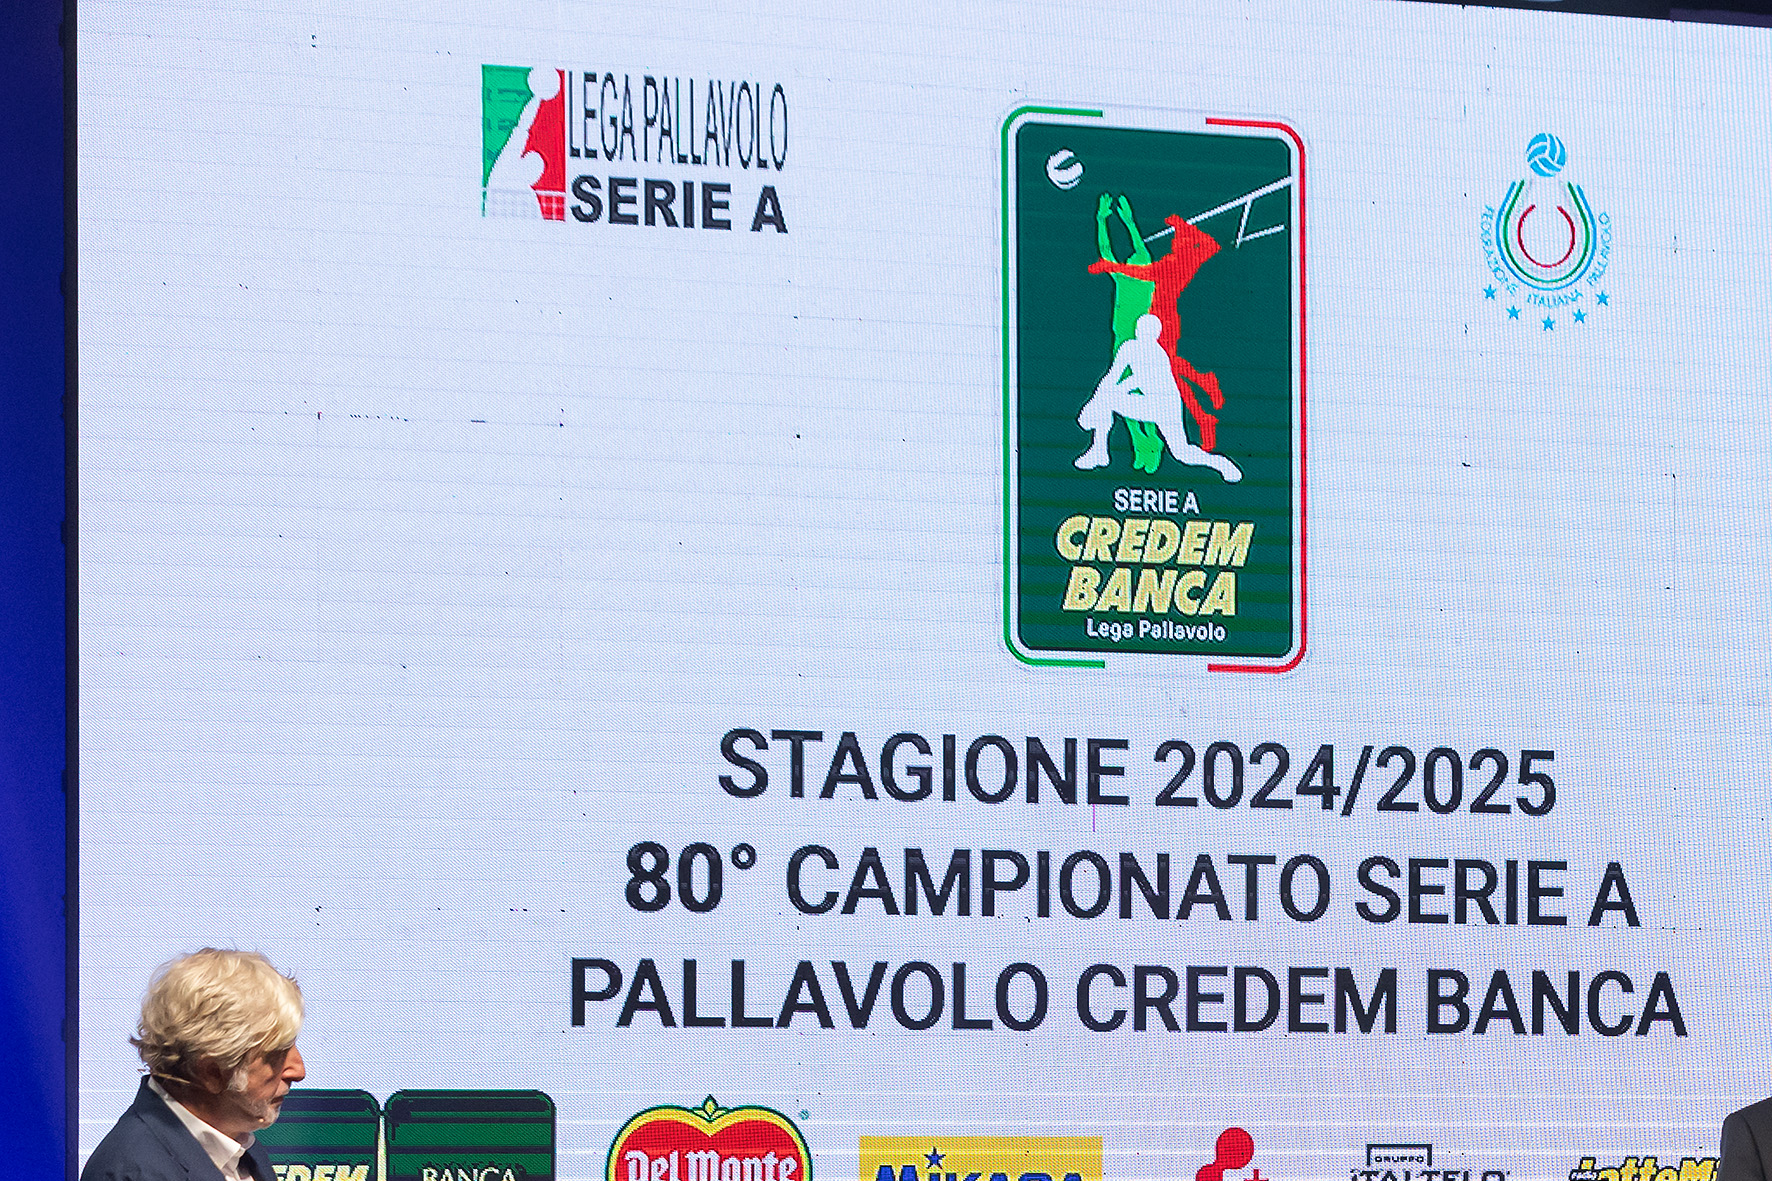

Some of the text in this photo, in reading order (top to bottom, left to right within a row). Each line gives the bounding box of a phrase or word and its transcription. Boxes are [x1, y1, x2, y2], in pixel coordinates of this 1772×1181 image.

[568, 70, 789, 172] LEGA PALLAVOLO
[570, 174, 789, 234] SERIE A
[1114, 488, 1200, 515] SERIE A
[1055, 514, 1256, 568] CREDEM
[1062, 565, 1238, 617] BANCA
[1086, 617, 1227, 643] Lega Pallavolo
[718, 728, 1557, 817] STAGIONE 2024/2025
[625, 841, 1642, 928] 80° CAMPIONATO SERIE A
[571, 957, 1688, 1037] PALLAVOLO CREDEM BANCA
[1374, 1155, 1425, 1163] GRUPPO
